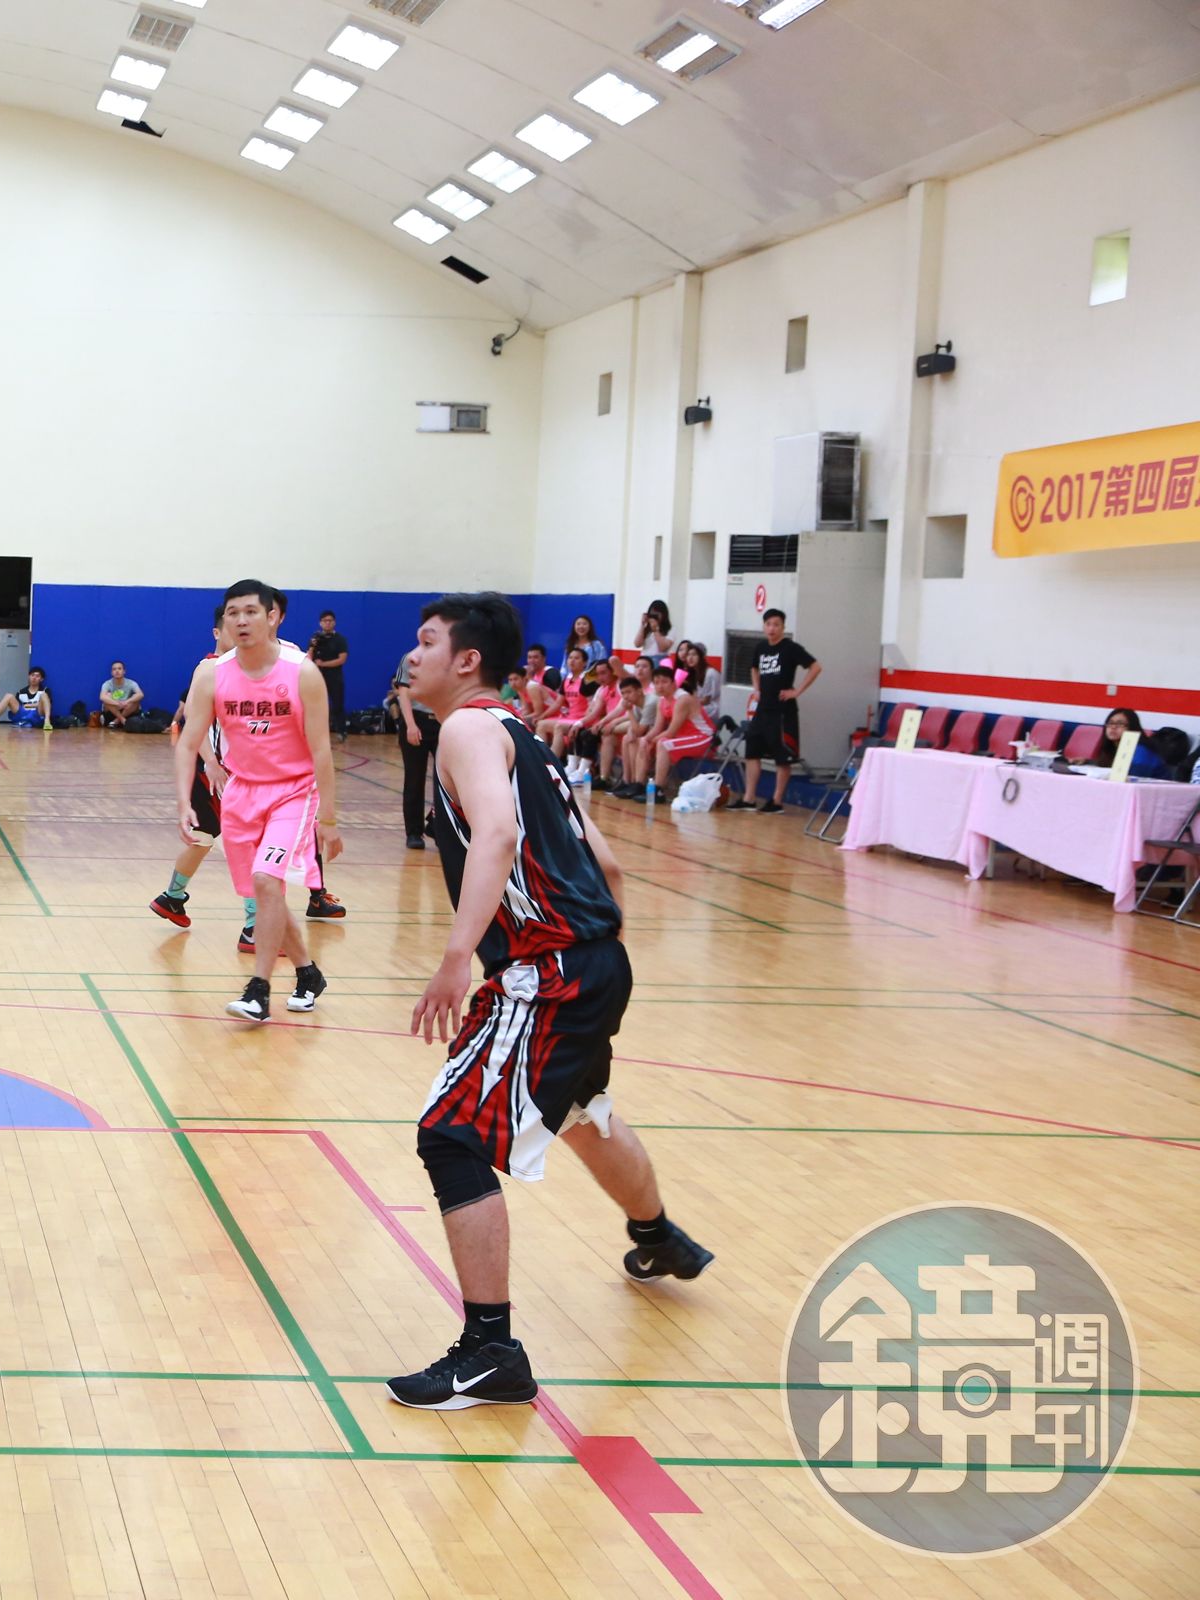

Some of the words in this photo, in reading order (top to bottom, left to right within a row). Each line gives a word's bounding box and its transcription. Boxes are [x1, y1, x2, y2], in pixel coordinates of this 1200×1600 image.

[1040, 455, 1200, 524] 2017第四屆
[224, 700, 292, 717] 永慶房屋
[248, 720, 271, 735] 77
[264, 846, 287, 864] 77
